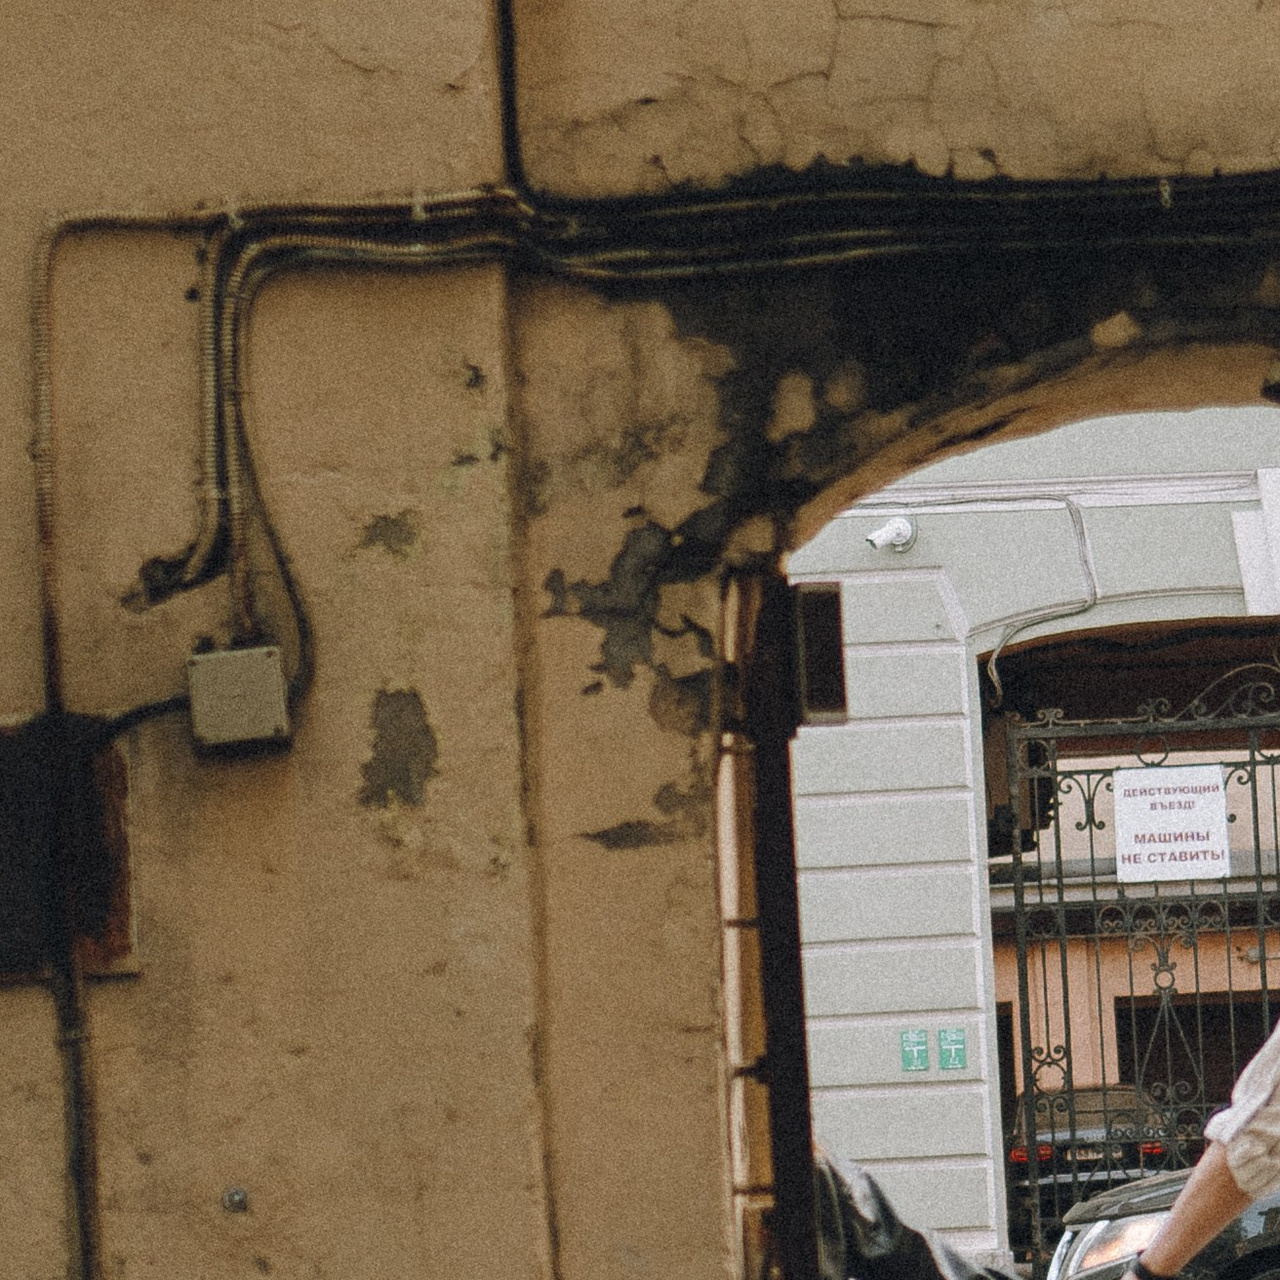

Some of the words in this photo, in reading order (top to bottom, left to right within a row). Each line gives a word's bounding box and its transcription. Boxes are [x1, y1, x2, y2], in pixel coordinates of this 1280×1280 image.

[1123, 784, 1219, 798] ДЕЙСТВУЮЩИЙ
[1150, 801, 1196, 811] ВЪЕЗД!
[1134, 831, 1210, 845] МАШИНЫ
[1121, 853, 1142, 864] НЕ
[1147, 849, 1225, 863] СТАВИТЬ!
